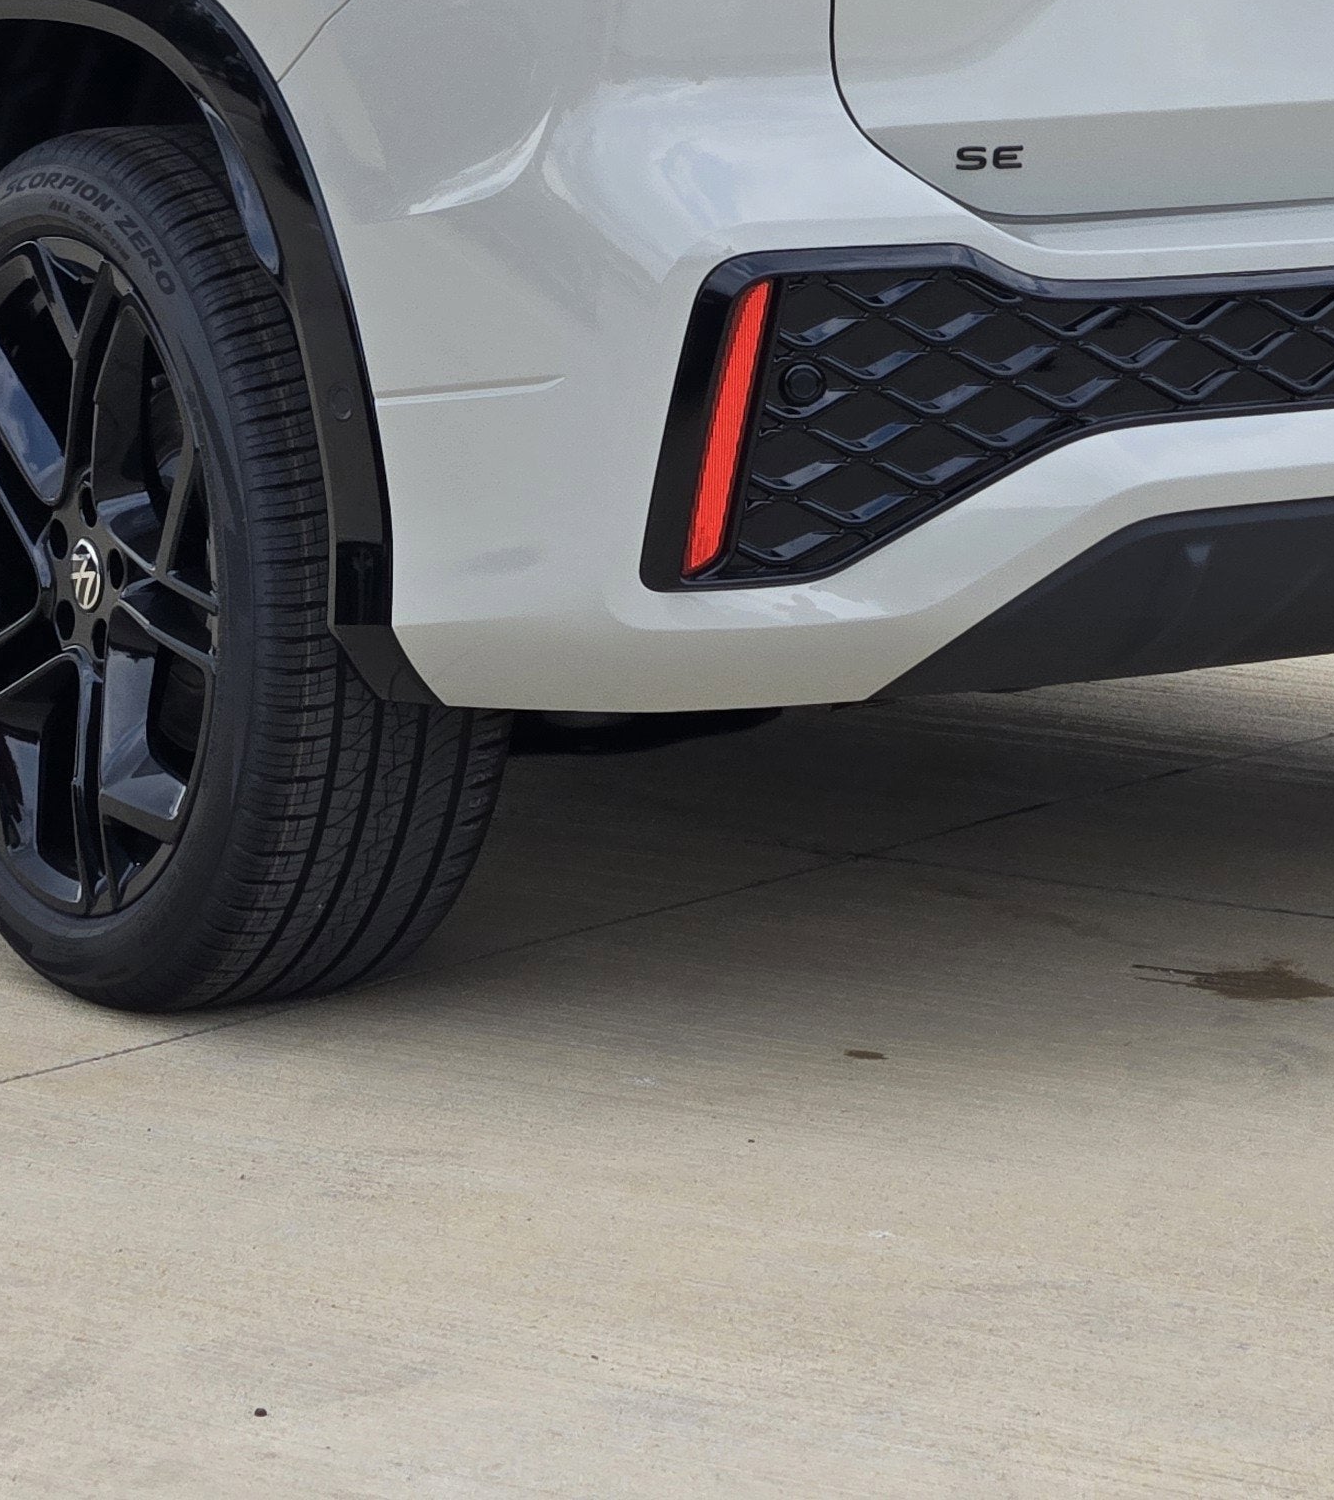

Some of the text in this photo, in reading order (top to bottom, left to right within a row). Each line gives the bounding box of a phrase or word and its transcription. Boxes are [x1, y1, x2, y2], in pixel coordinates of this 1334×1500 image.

[955, 145, 1024, 171] SE
[0, 172, 176, 296] SCORPION ZERO
